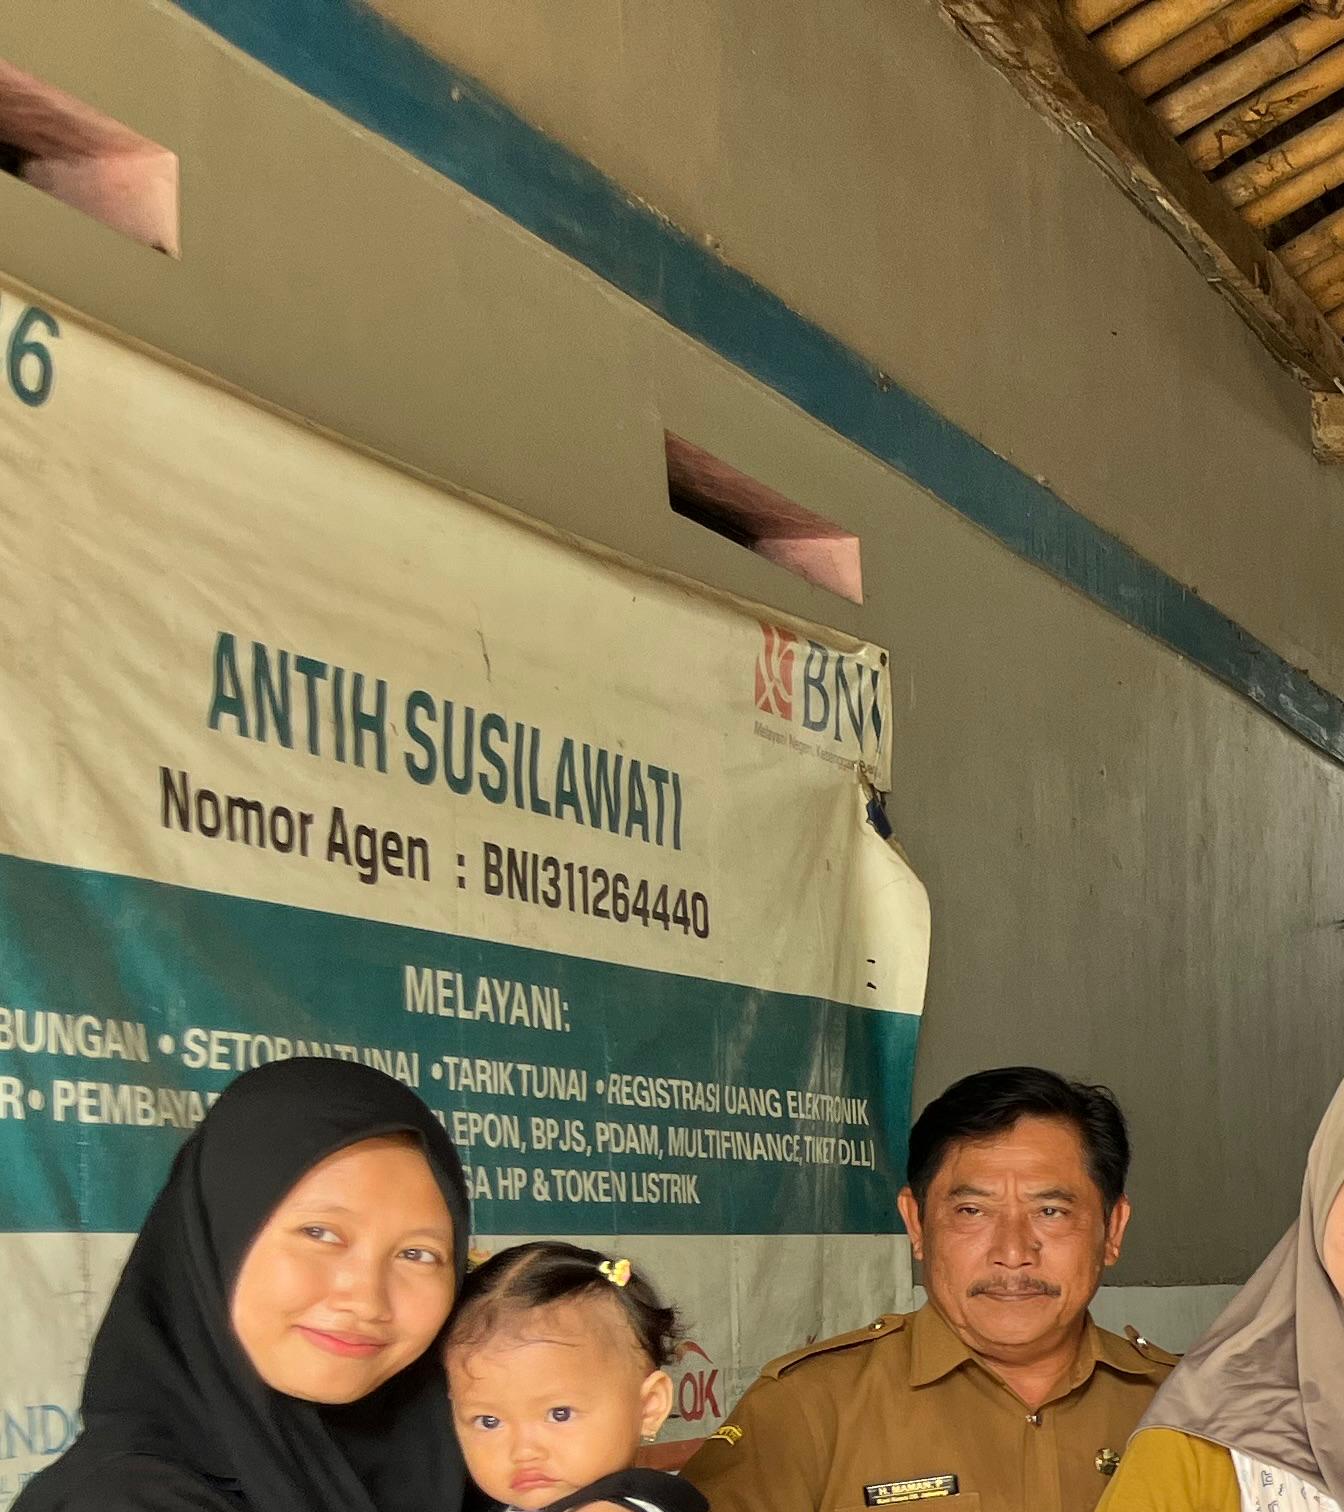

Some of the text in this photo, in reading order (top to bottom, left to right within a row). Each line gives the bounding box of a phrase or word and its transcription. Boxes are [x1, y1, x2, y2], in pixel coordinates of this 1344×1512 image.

[6, 306, 60, 408] 6
[802, 639, 882, 753] BNI
[206, 632, 685, 852] ANTIH SUSILAWATI
[159, 767, 312, 857] Nomor
[327, 807, 431, 885] Agen
[483, 842, 710, 939] BNI311264440
[404, 964, 572, 1033] MELAYANI:
[516, 1063, 587, 1102] TUNAI
[724, 1086, 782, 1119] UANG
[786, 1090, 869, 1126] ELEKTRONIK
[496, 1166, 528, 1201] HP
[532, 1168, 553, 1202] &
[551, 1169, 627, 1203] TOKEN
[632, 1175, 701, 1205] LISTRIK
[531, 1116, 591, 1157] BPJS,
[596, 1121, 664, 1160] PDAM,
[668, 1127, 802, 1167] MULTIFINANCE,
[803, 1135, 836, 1164] TIKET
[838, 1139, 876, 1172] DLL)
